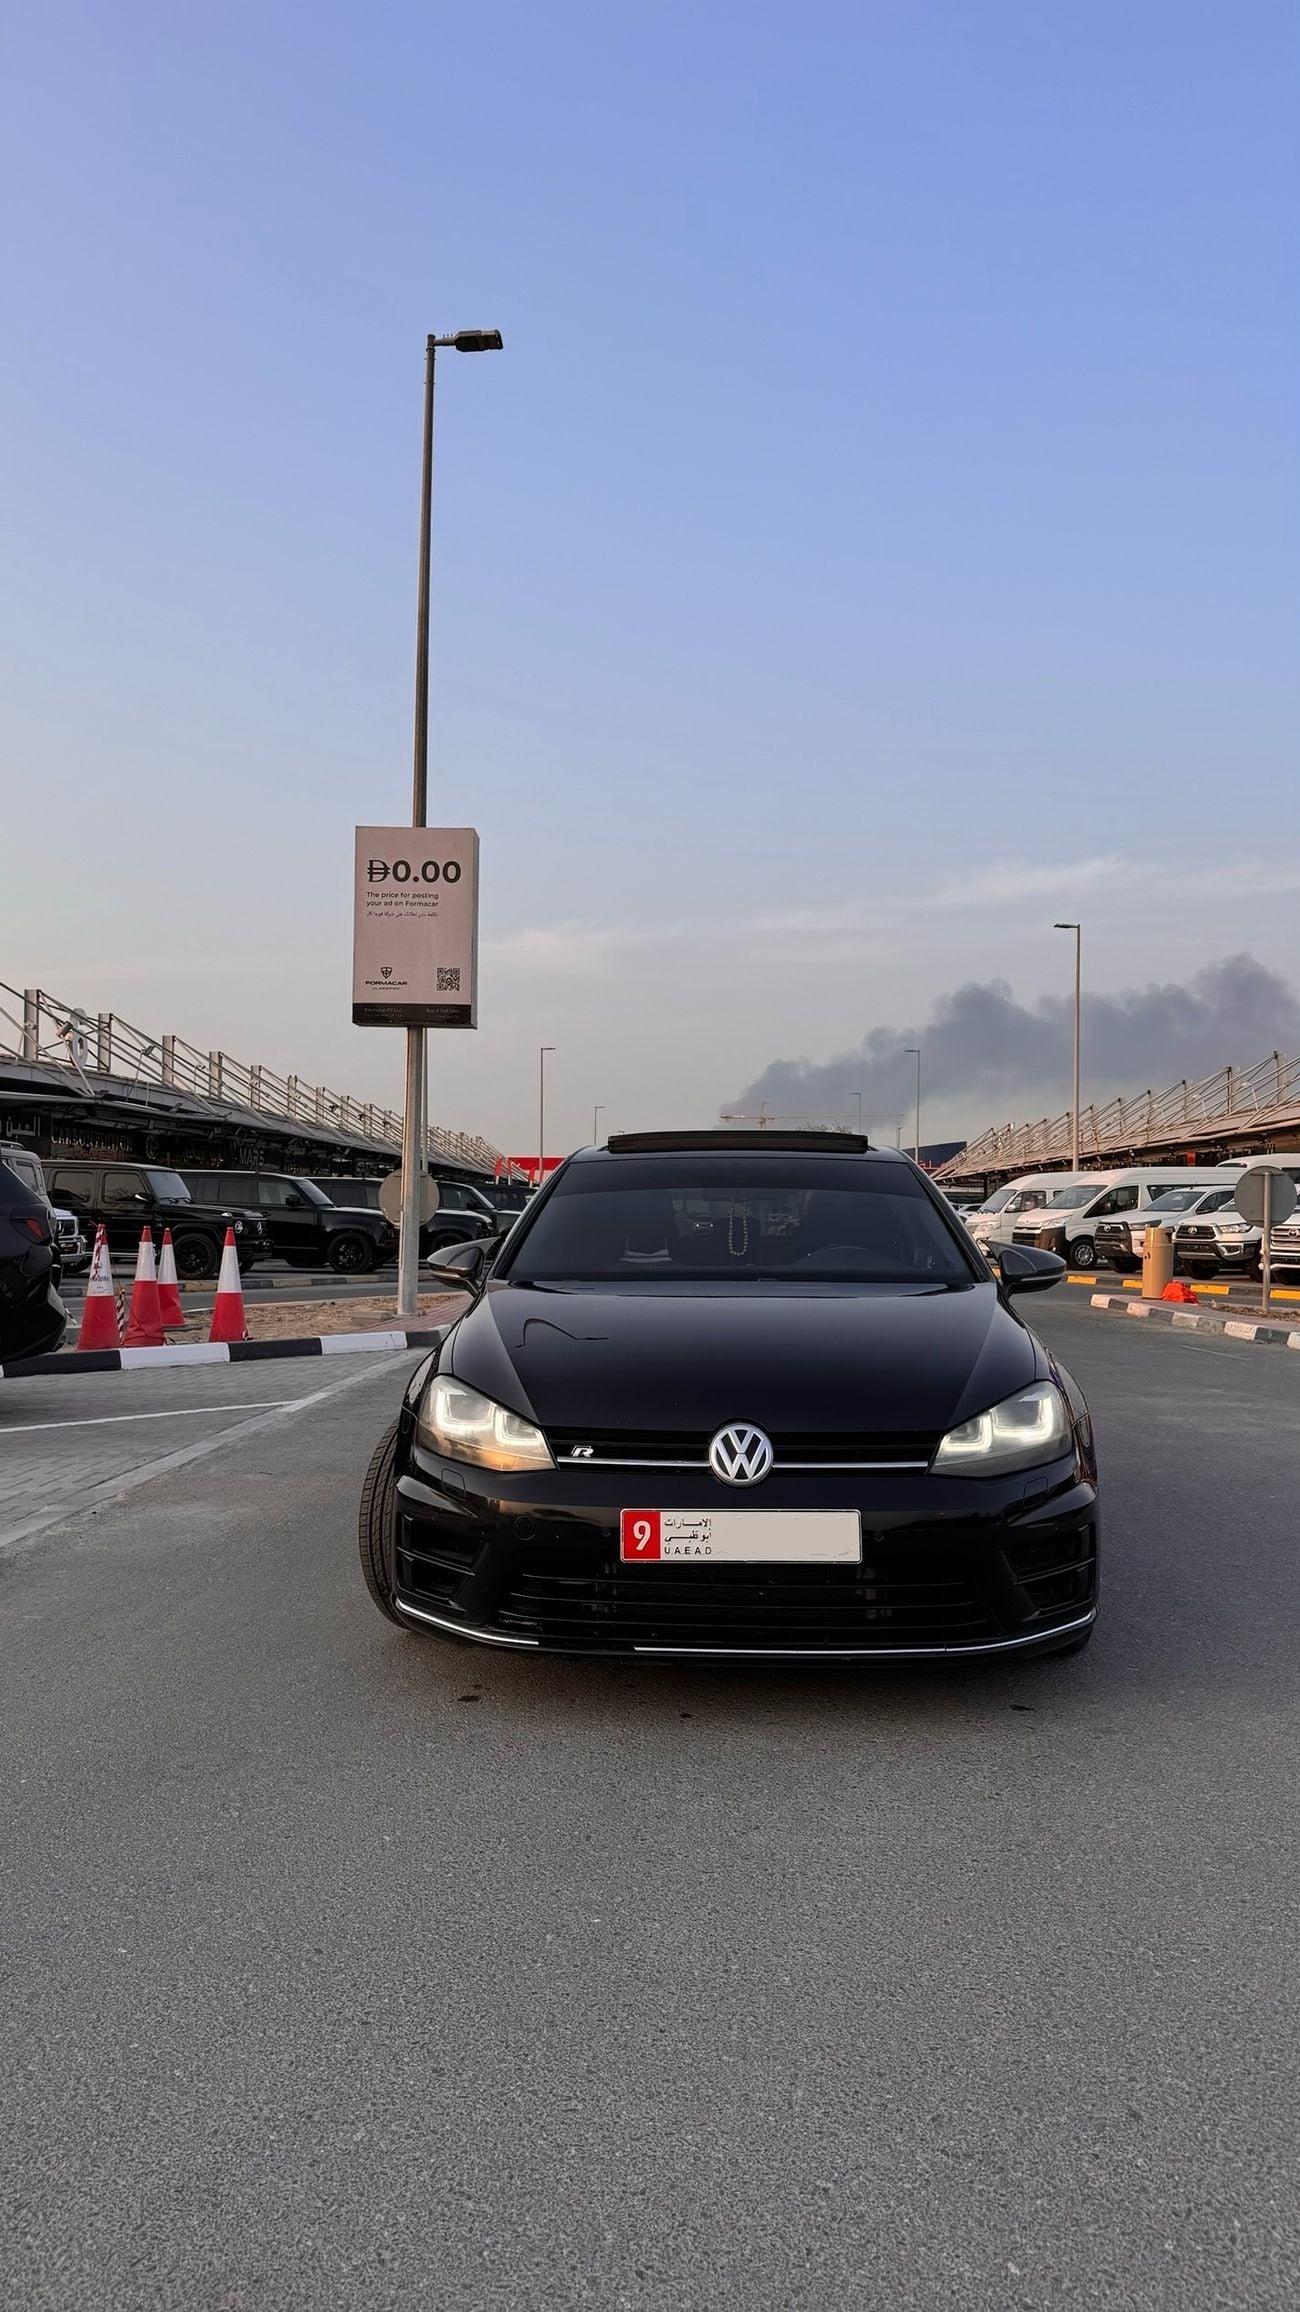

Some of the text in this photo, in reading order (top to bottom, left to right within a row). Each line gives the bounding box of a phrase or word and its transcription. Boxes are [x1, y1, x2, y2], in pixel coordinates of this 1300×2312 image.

[381, 891, 399, 900] price
[412, 892, 439, 900] posting
[405, 900, 439, 908] Formacar
[570, 1444, 594, 1458] R
[711, 1425, 771, 1484] VW
[633, 1520, 651, 1551] 9
